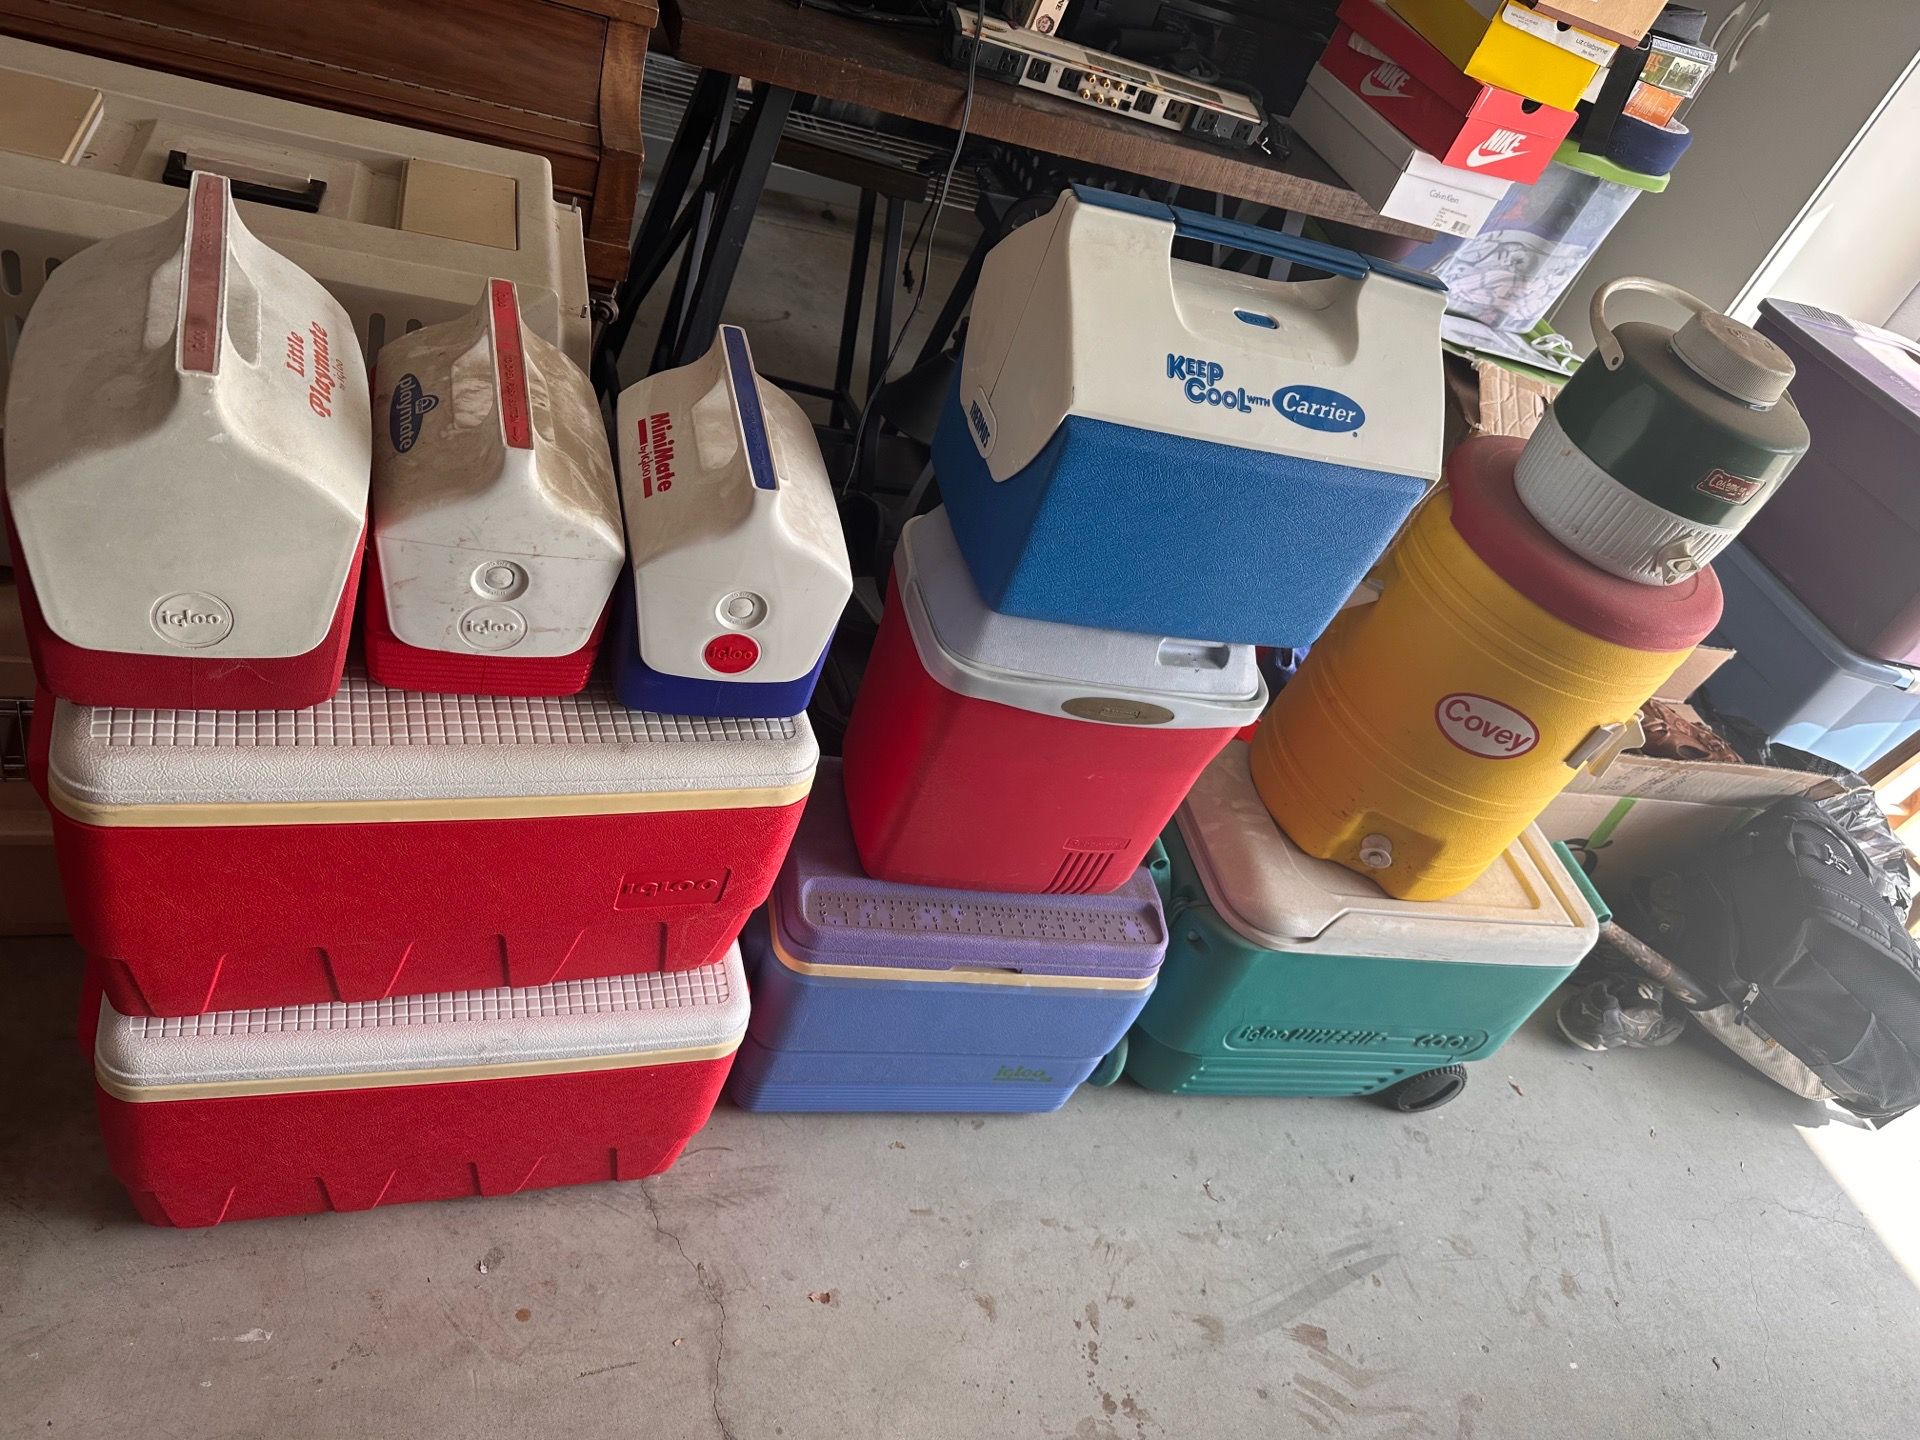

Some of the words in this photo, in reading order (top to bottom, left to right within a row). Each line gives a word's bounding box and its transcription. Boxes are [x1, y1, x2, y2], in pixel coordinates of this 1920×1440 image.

[1372, 62, 1411, 91] NIKE
[1482, 128, 1528, 153] NIKE
[287, 328, 304, 378] Little
[309, 321, 335, 417] Playmate
[1167, 353, 1224, 386] KEEP
[396, 376, 413, 449] playmate
[1184, 377, 1251, 413] COOL
[1246, 394, 1271, 408] WITH
[1282, 391, 1357, 423] Carrier
[650, 412, 675, 492] MiniMate
[162, 609, 223, 627] igloo
[466, 619, 518, 635] igloo
[1445, 699, 1532, 752] Covey
